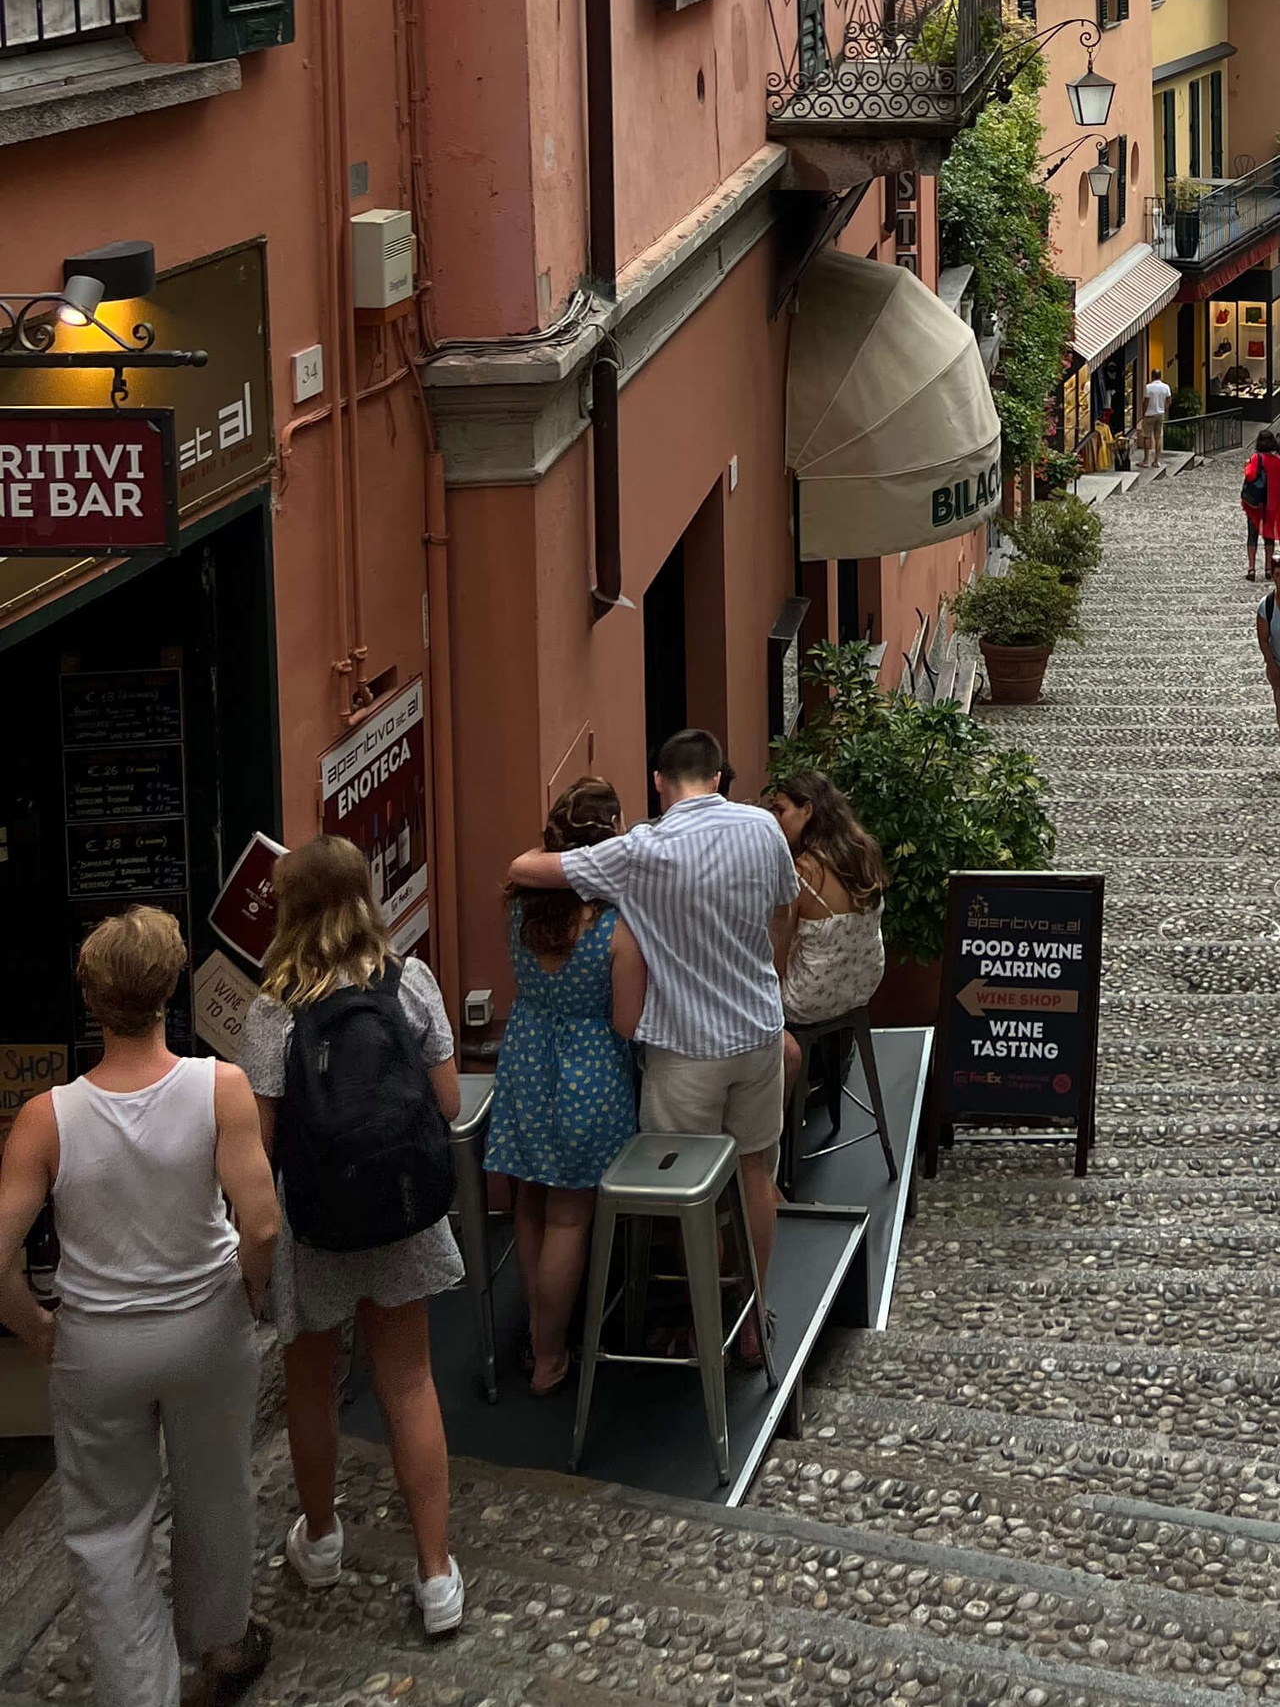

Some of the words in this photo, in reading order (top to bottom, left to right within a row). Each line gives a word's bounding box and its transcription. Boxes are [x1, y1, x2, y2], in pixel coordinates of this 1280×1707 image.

[302, 361, 318, 384] 34
[178, 426, 213, 471] et
[218, 380, 253, 450] al
[0, 444, 145, 480] RITIVI
[49, 482, 144, 517] BAR
[337, 737, 411, 820] ENOTECA
[967, 915, 1049, 931] aperitivo
[961, 939, 1014, 957] FOOD
[1017, 942, 1030, 958] &
[1032, 942, 1083, 960] WINE
[980, 959, 1062, 979] PAIRING
[214, 978, 246, 1012] WINE
[976, 991, 1017, 1005] WINE
[1020, 993, 1062, 1007] SHOP
[206, 997, 223, 1018] TO
[222, 1016, 242, 1036] GO
[989, 1019, 1044, 1039] WINE
[970, 1039, 1059, 1060] TASTING
[3, 1049, 65, 1083] SHOP
